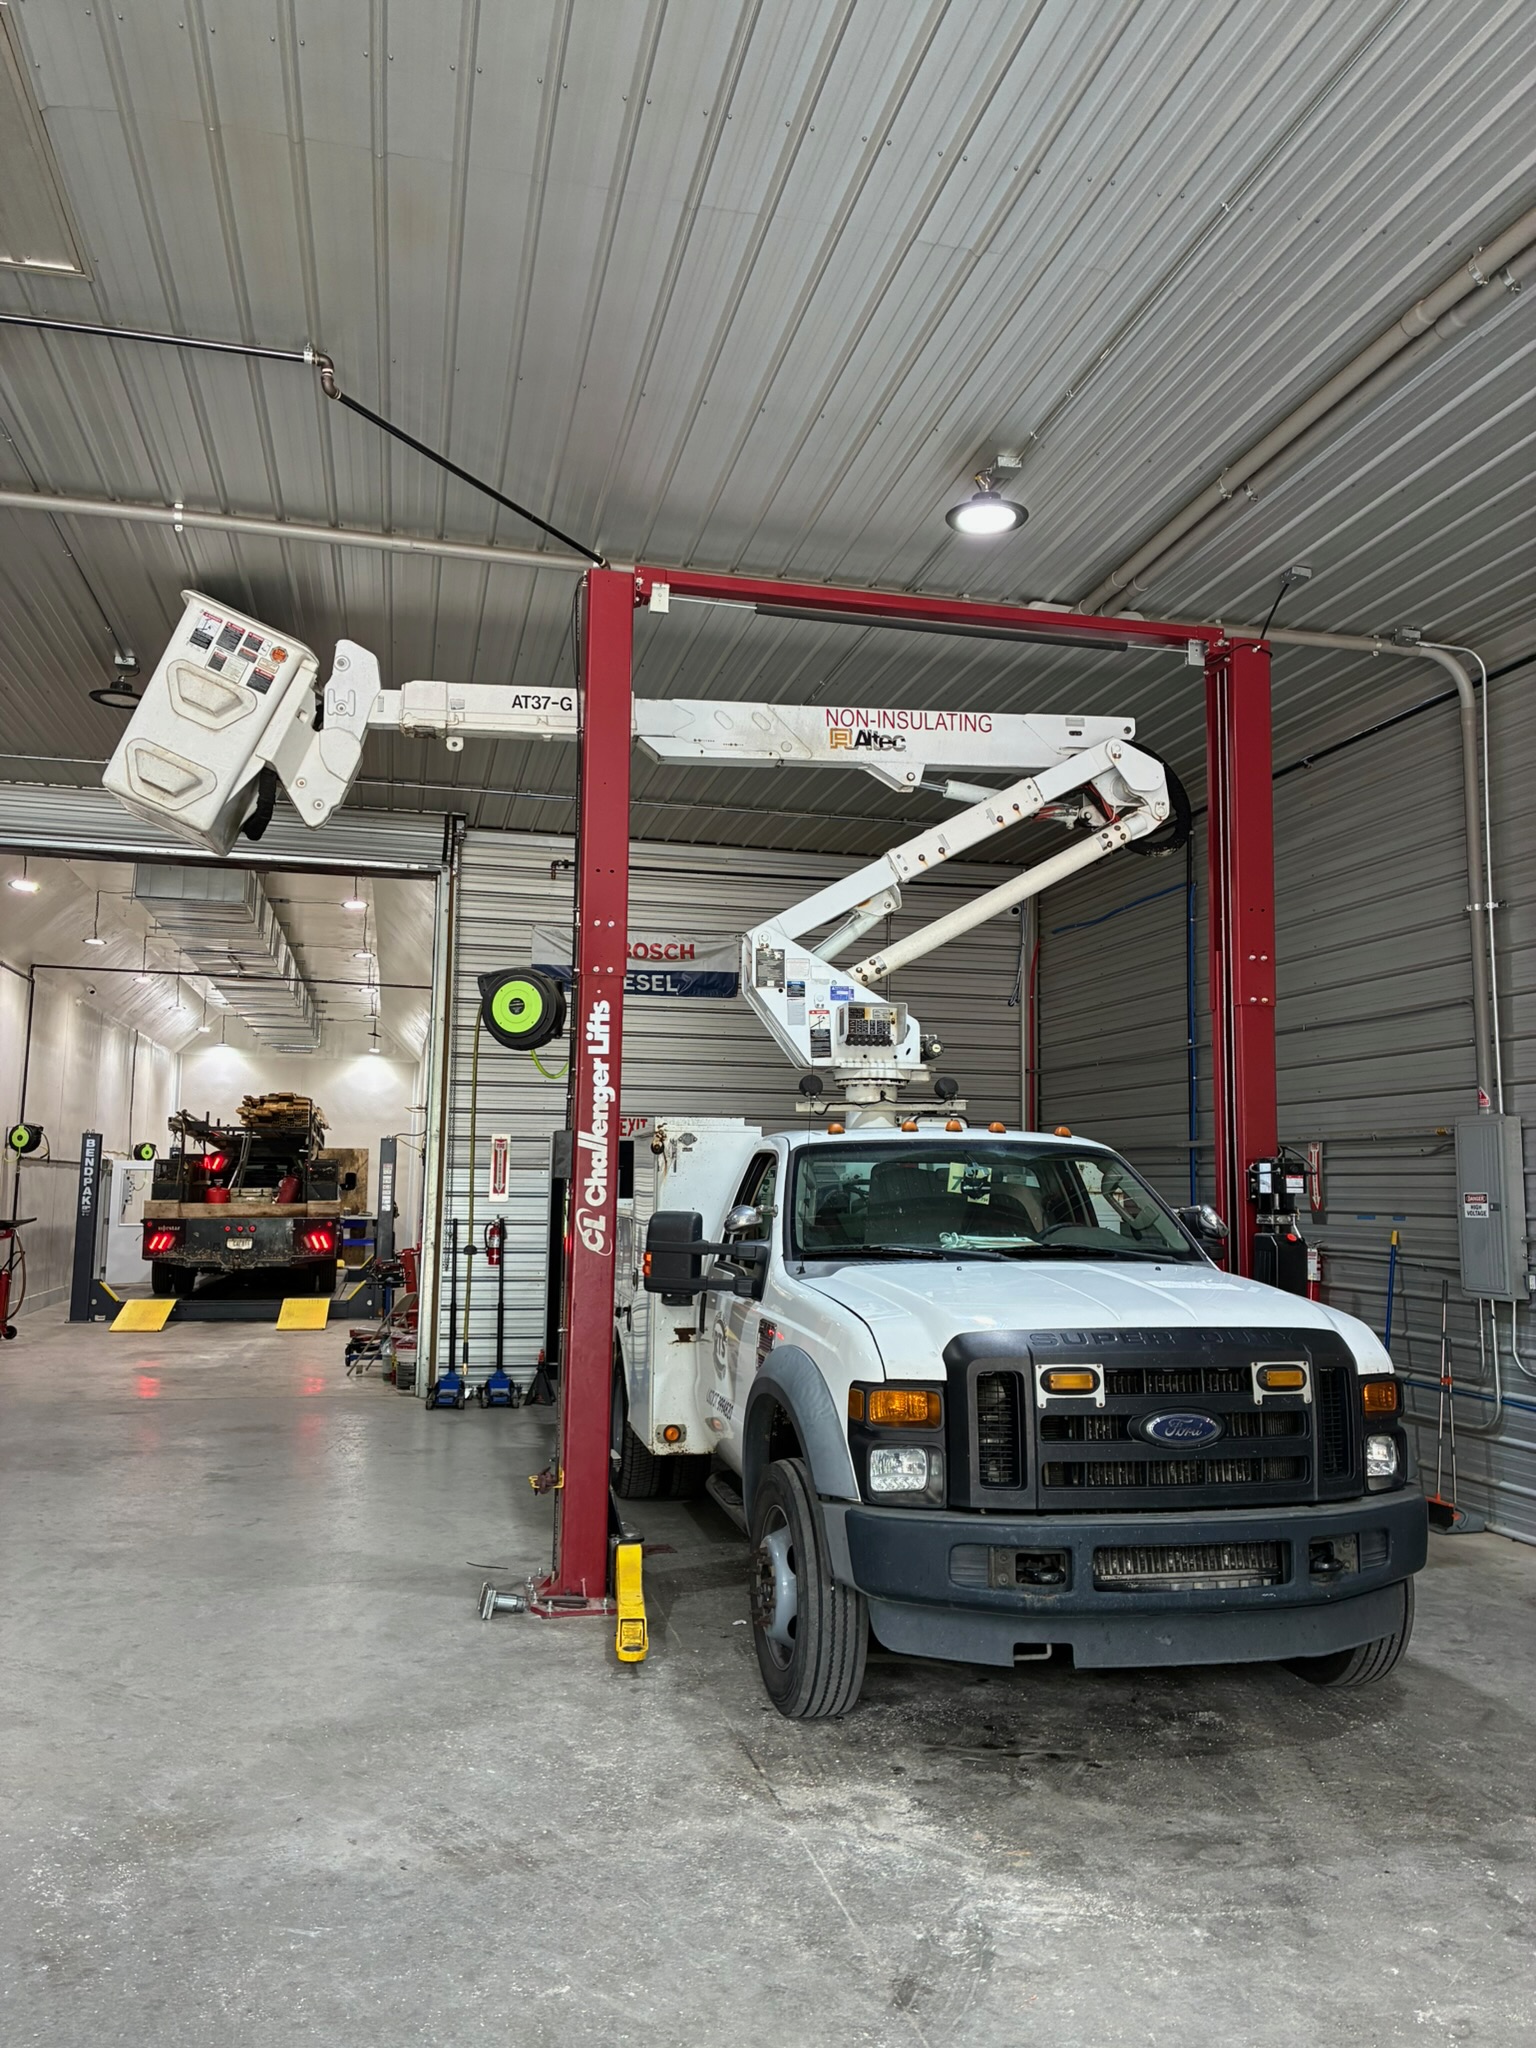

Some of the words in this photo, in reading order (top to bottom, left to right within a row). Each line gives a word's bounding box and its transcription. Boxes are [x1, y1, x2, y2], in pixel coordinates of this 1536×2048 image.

[511, 694, 573, 712] AT37-G
[825, 708, 993, 733] NON-INSULATING
[854, 728, 907, 751] Altec
[624, 973, 678, 992] ESEL
[586, 999, 611, 1055] Lifts
[577, 1058, 616, 1207] Challenger
[619, 1118, 648, 1137] EXIT
[81, 1138, 96, 1205] BENDPAK
[1029, 1331, 1177, 1347] SUPER
[1163, 1418, 1204, 1437] Ford
